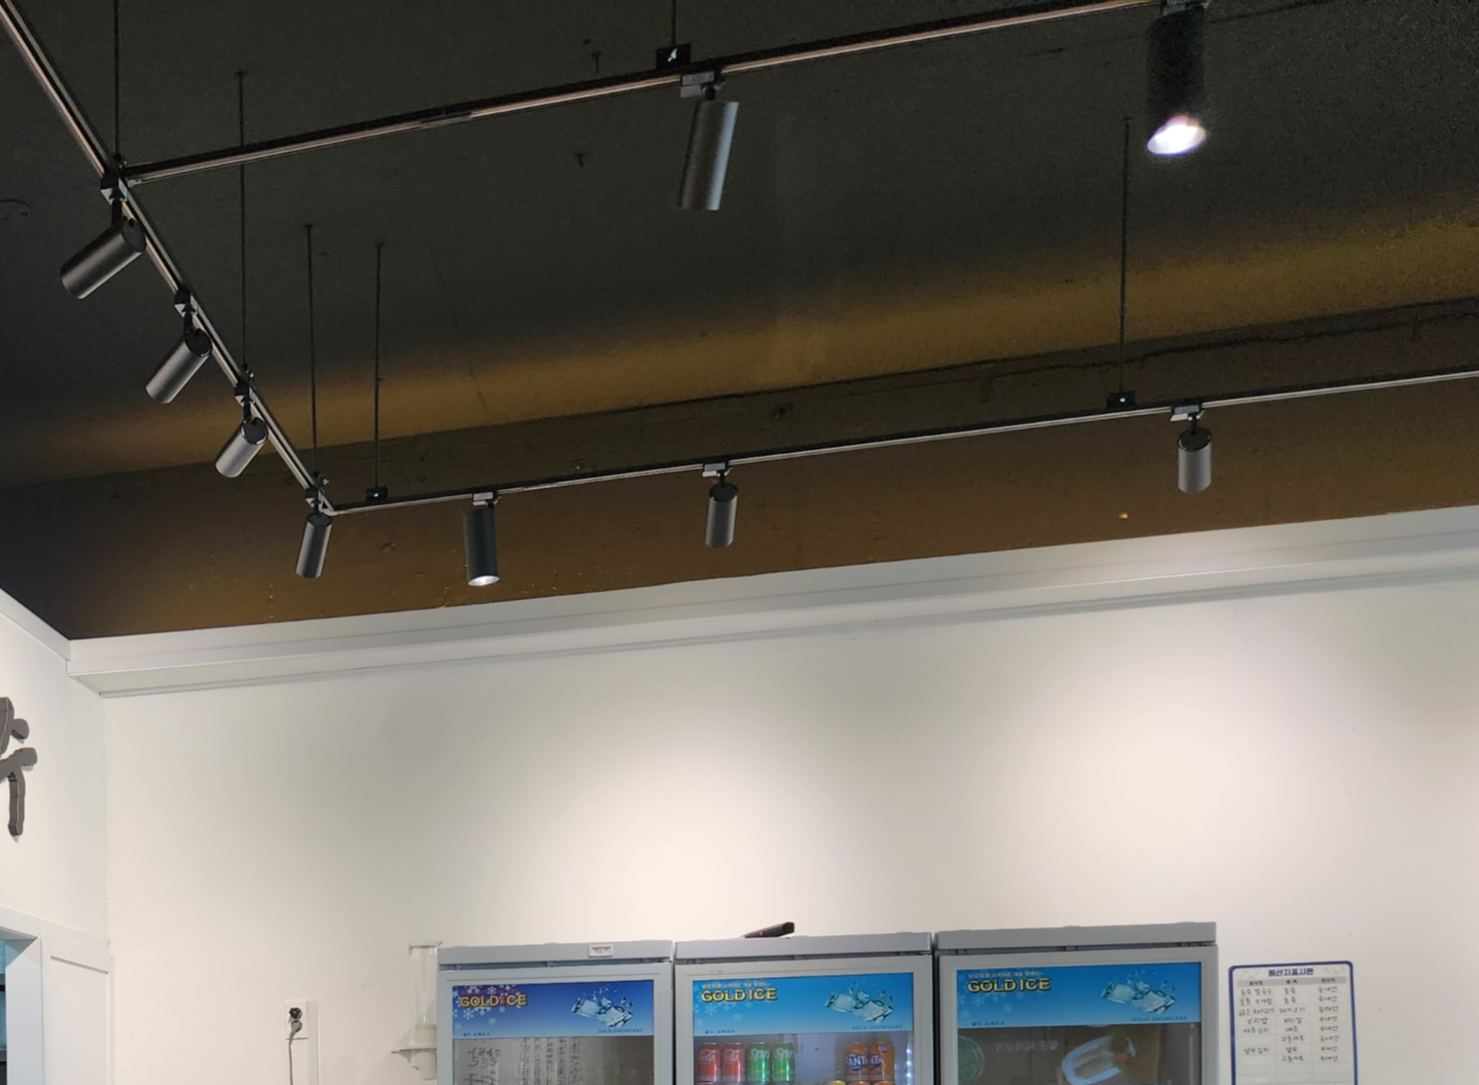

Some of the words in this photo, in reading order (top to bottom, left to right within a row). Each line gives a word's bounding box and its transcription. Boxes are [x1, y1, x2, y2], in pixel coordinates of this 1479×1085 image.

[967, 980, 1016, 992] GOLD
[1019, 978, 1051, 991] ICE
[459, 995, 499, 1008] GOLD
[501, 994, 527, 1006] ICE
[700, 989, 746, 1002] GOLD
[748, 987, 777, 1001] ICE
